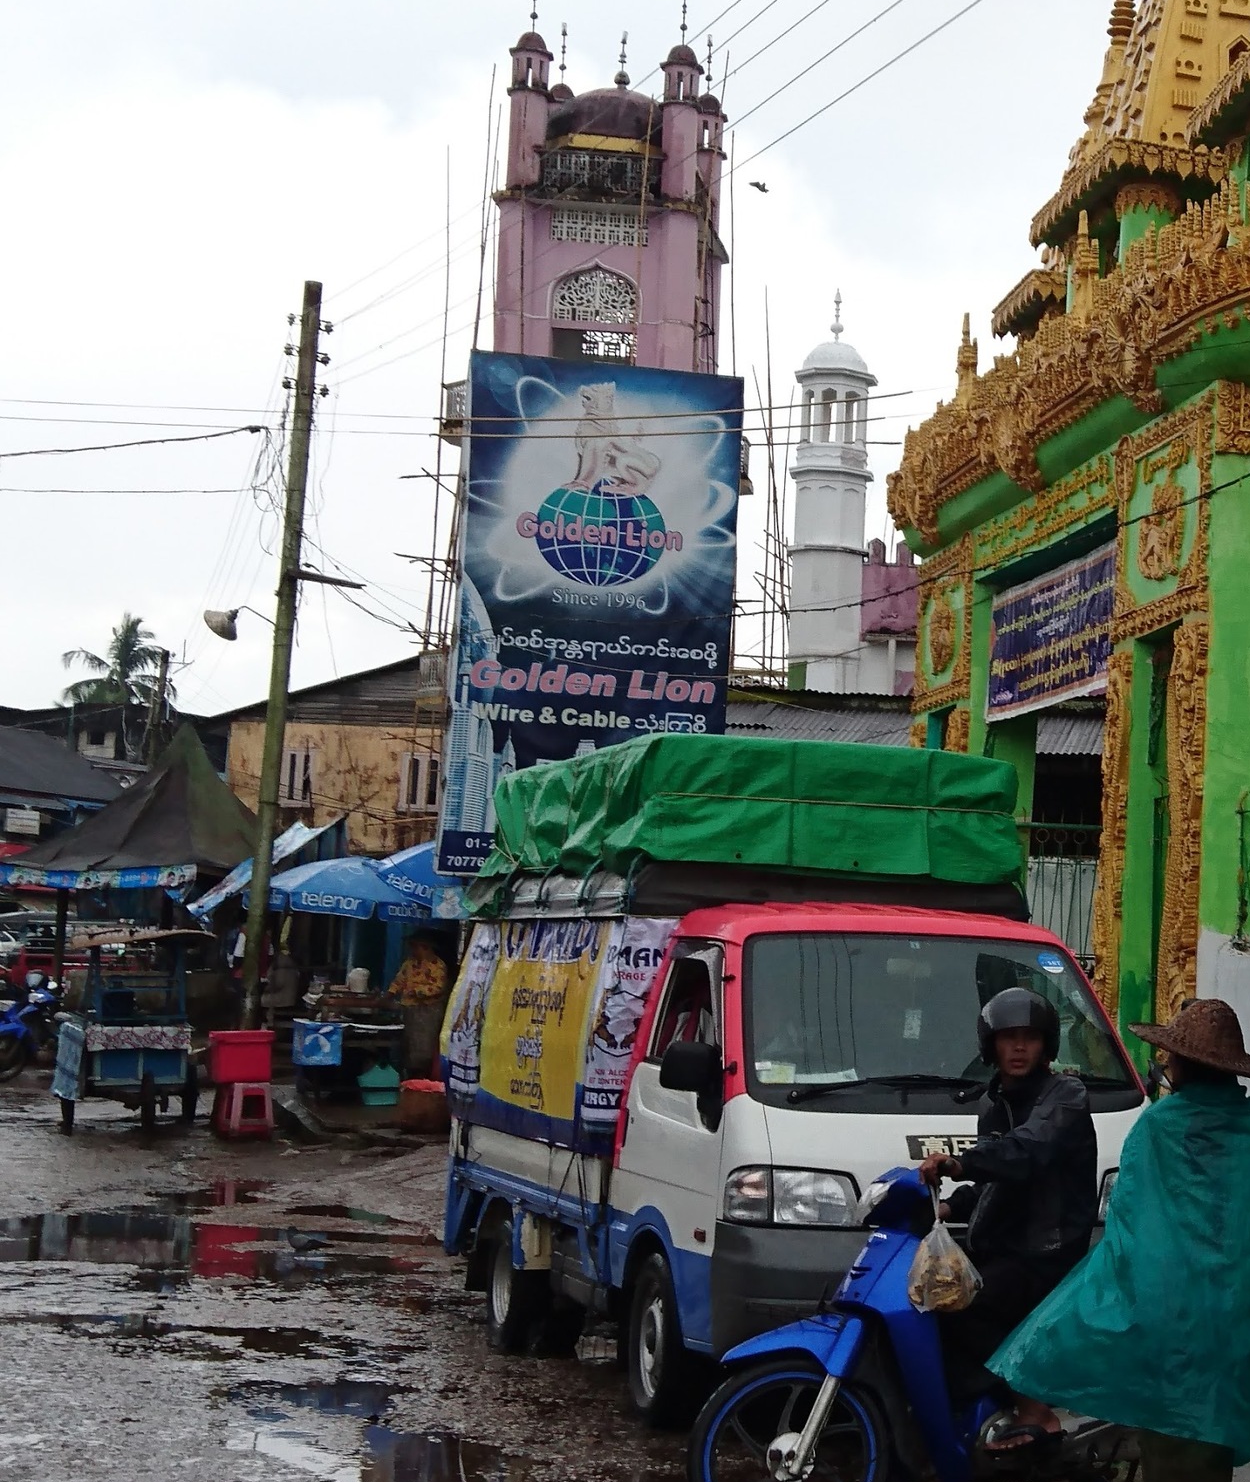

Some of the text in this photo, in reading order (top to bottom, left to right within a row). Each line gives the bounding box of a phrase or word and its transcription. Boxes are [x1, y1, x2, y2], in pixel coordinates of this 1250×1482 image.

[516, 511, 684, 552] Golden Lion
[552, 588, 647, 610] Since 1996
[469, 659, 716, 704] Golden Lion
[472, 701, 534, 723] Wire
[538, 706, 557, 725] &
[561, 707, 631, 730] Cable
[386, 872, 434, 899] telenor
[302, 891, 363, 911] telenor
